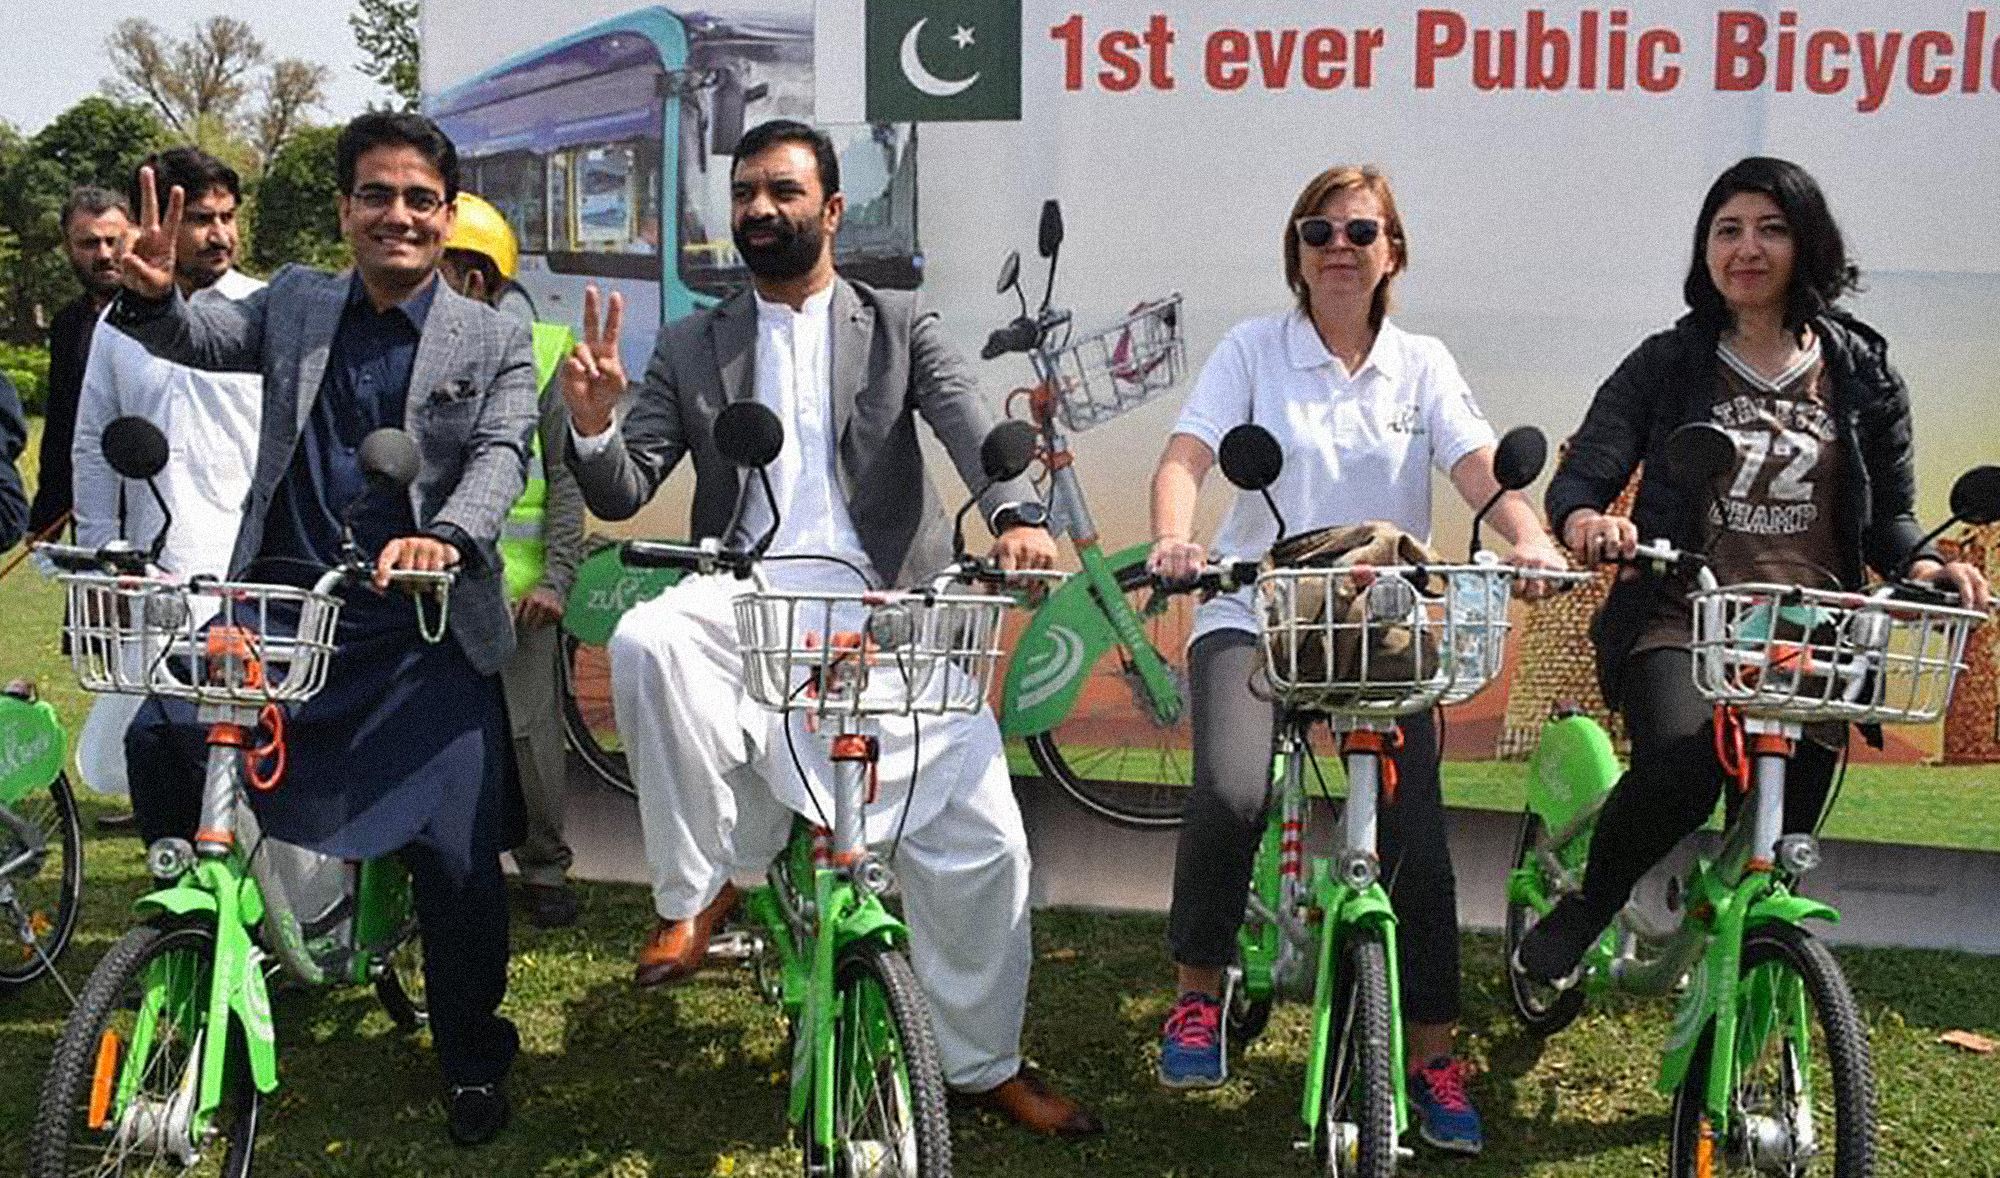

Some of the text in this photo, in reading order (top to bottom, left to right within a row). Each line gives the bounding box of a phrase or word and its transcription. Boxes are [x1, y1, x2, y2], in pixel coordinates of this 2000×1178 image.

[1050, 8, 2000, 112] 1st ever Public Bicycl
[1728, 428, 1818, 501] 72
[1708, 499, 1818, 534] CHAMP
